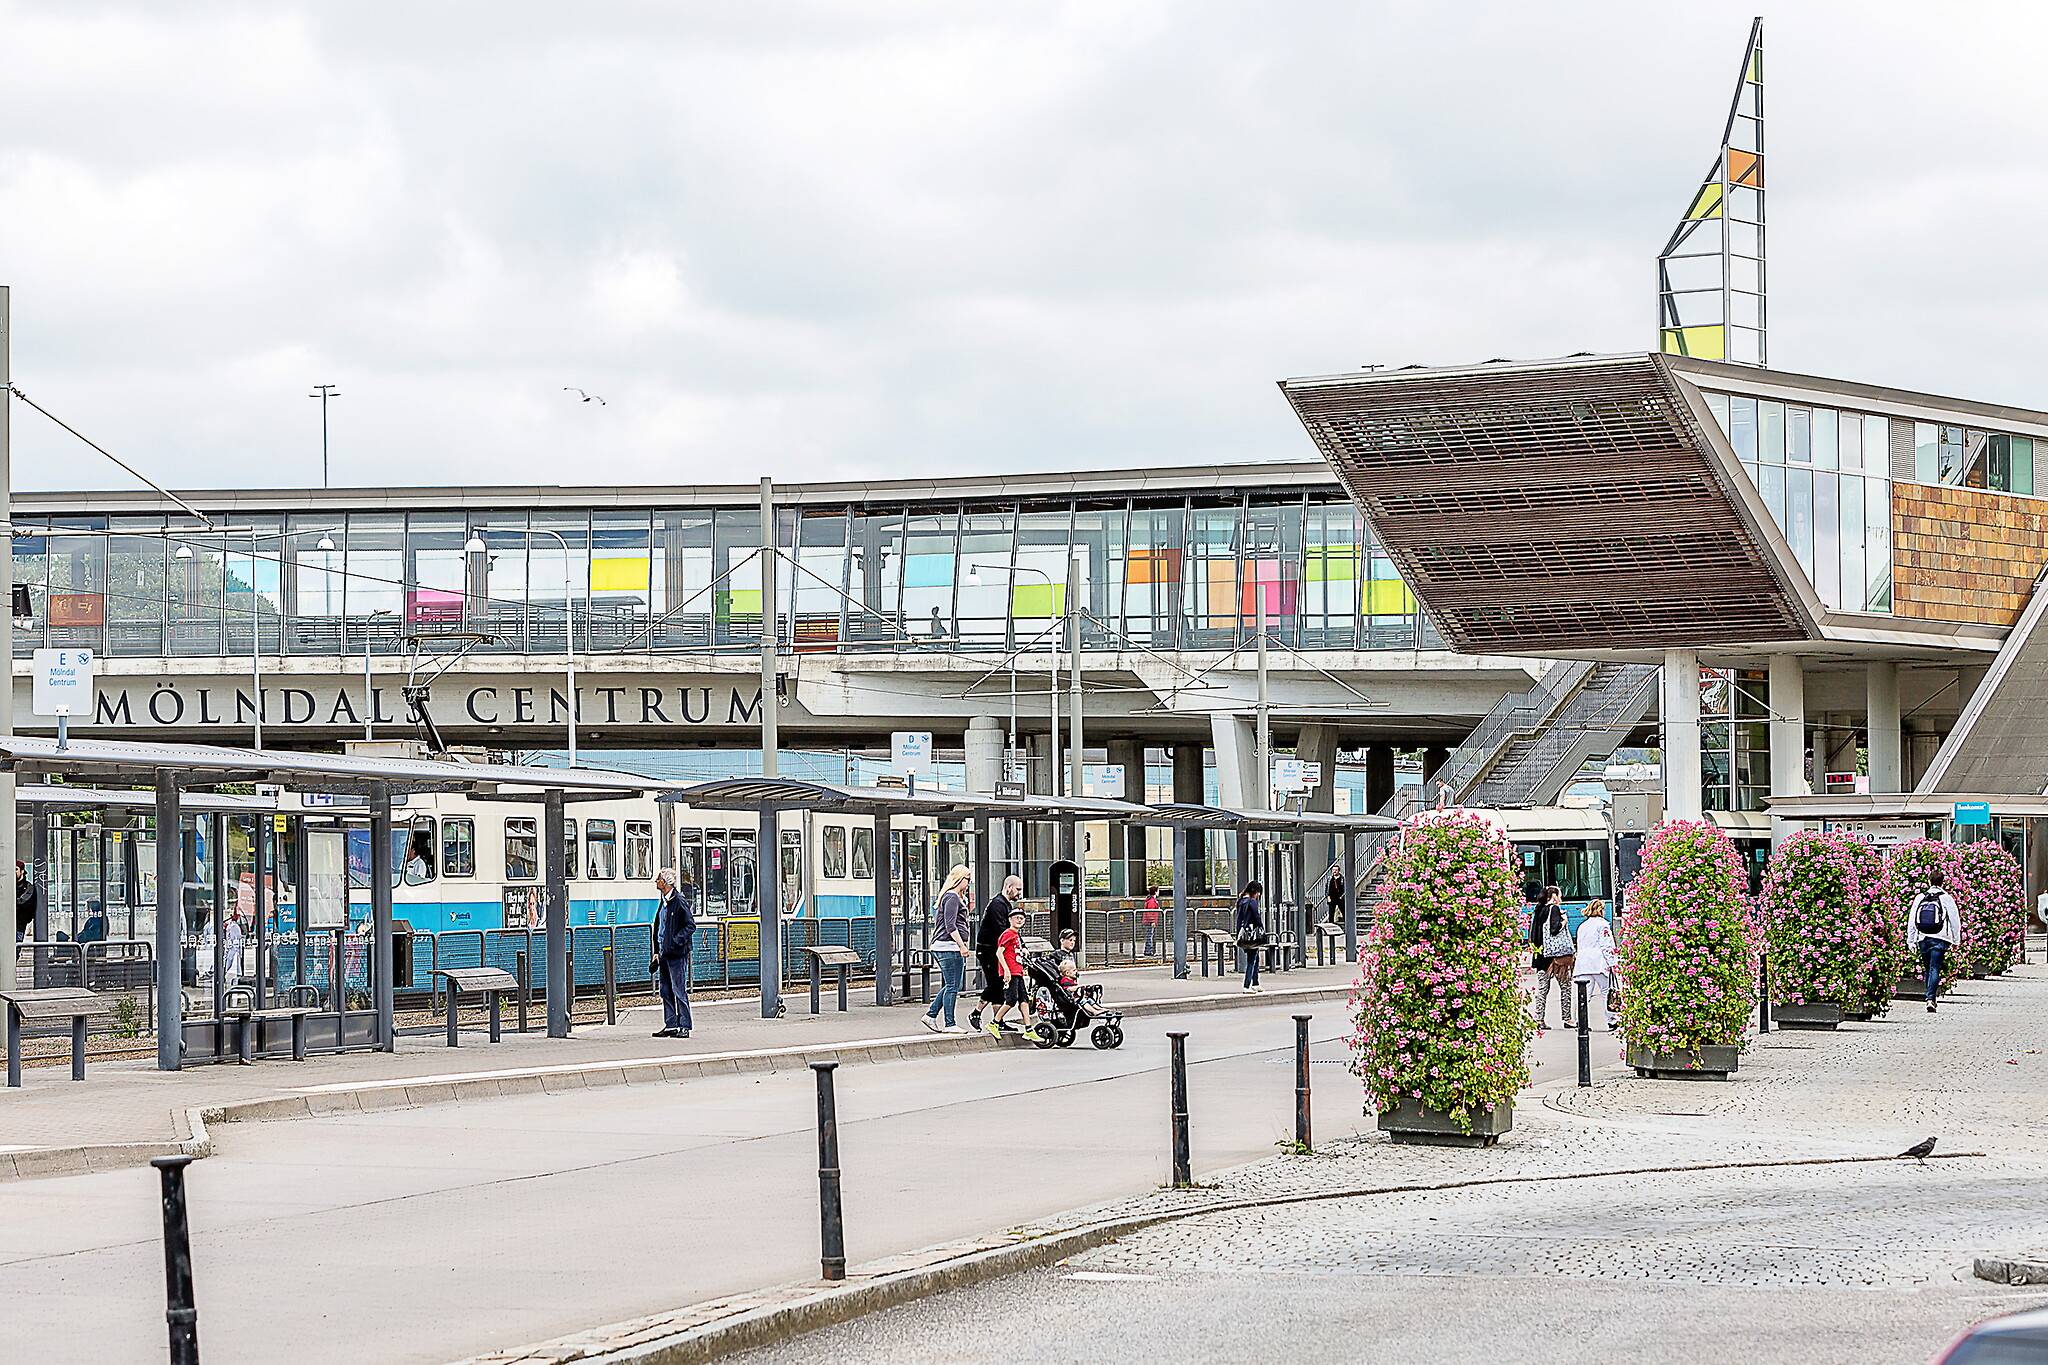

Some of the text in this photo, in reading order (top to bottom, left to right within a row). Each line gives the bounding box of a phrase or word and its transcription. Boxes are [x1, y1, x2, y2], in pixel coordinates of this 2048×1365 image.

[60, 652, 66, 665] E
[49, 677, 77, 686] Centrum
[466, 687, 764, 723] CENTRUM
